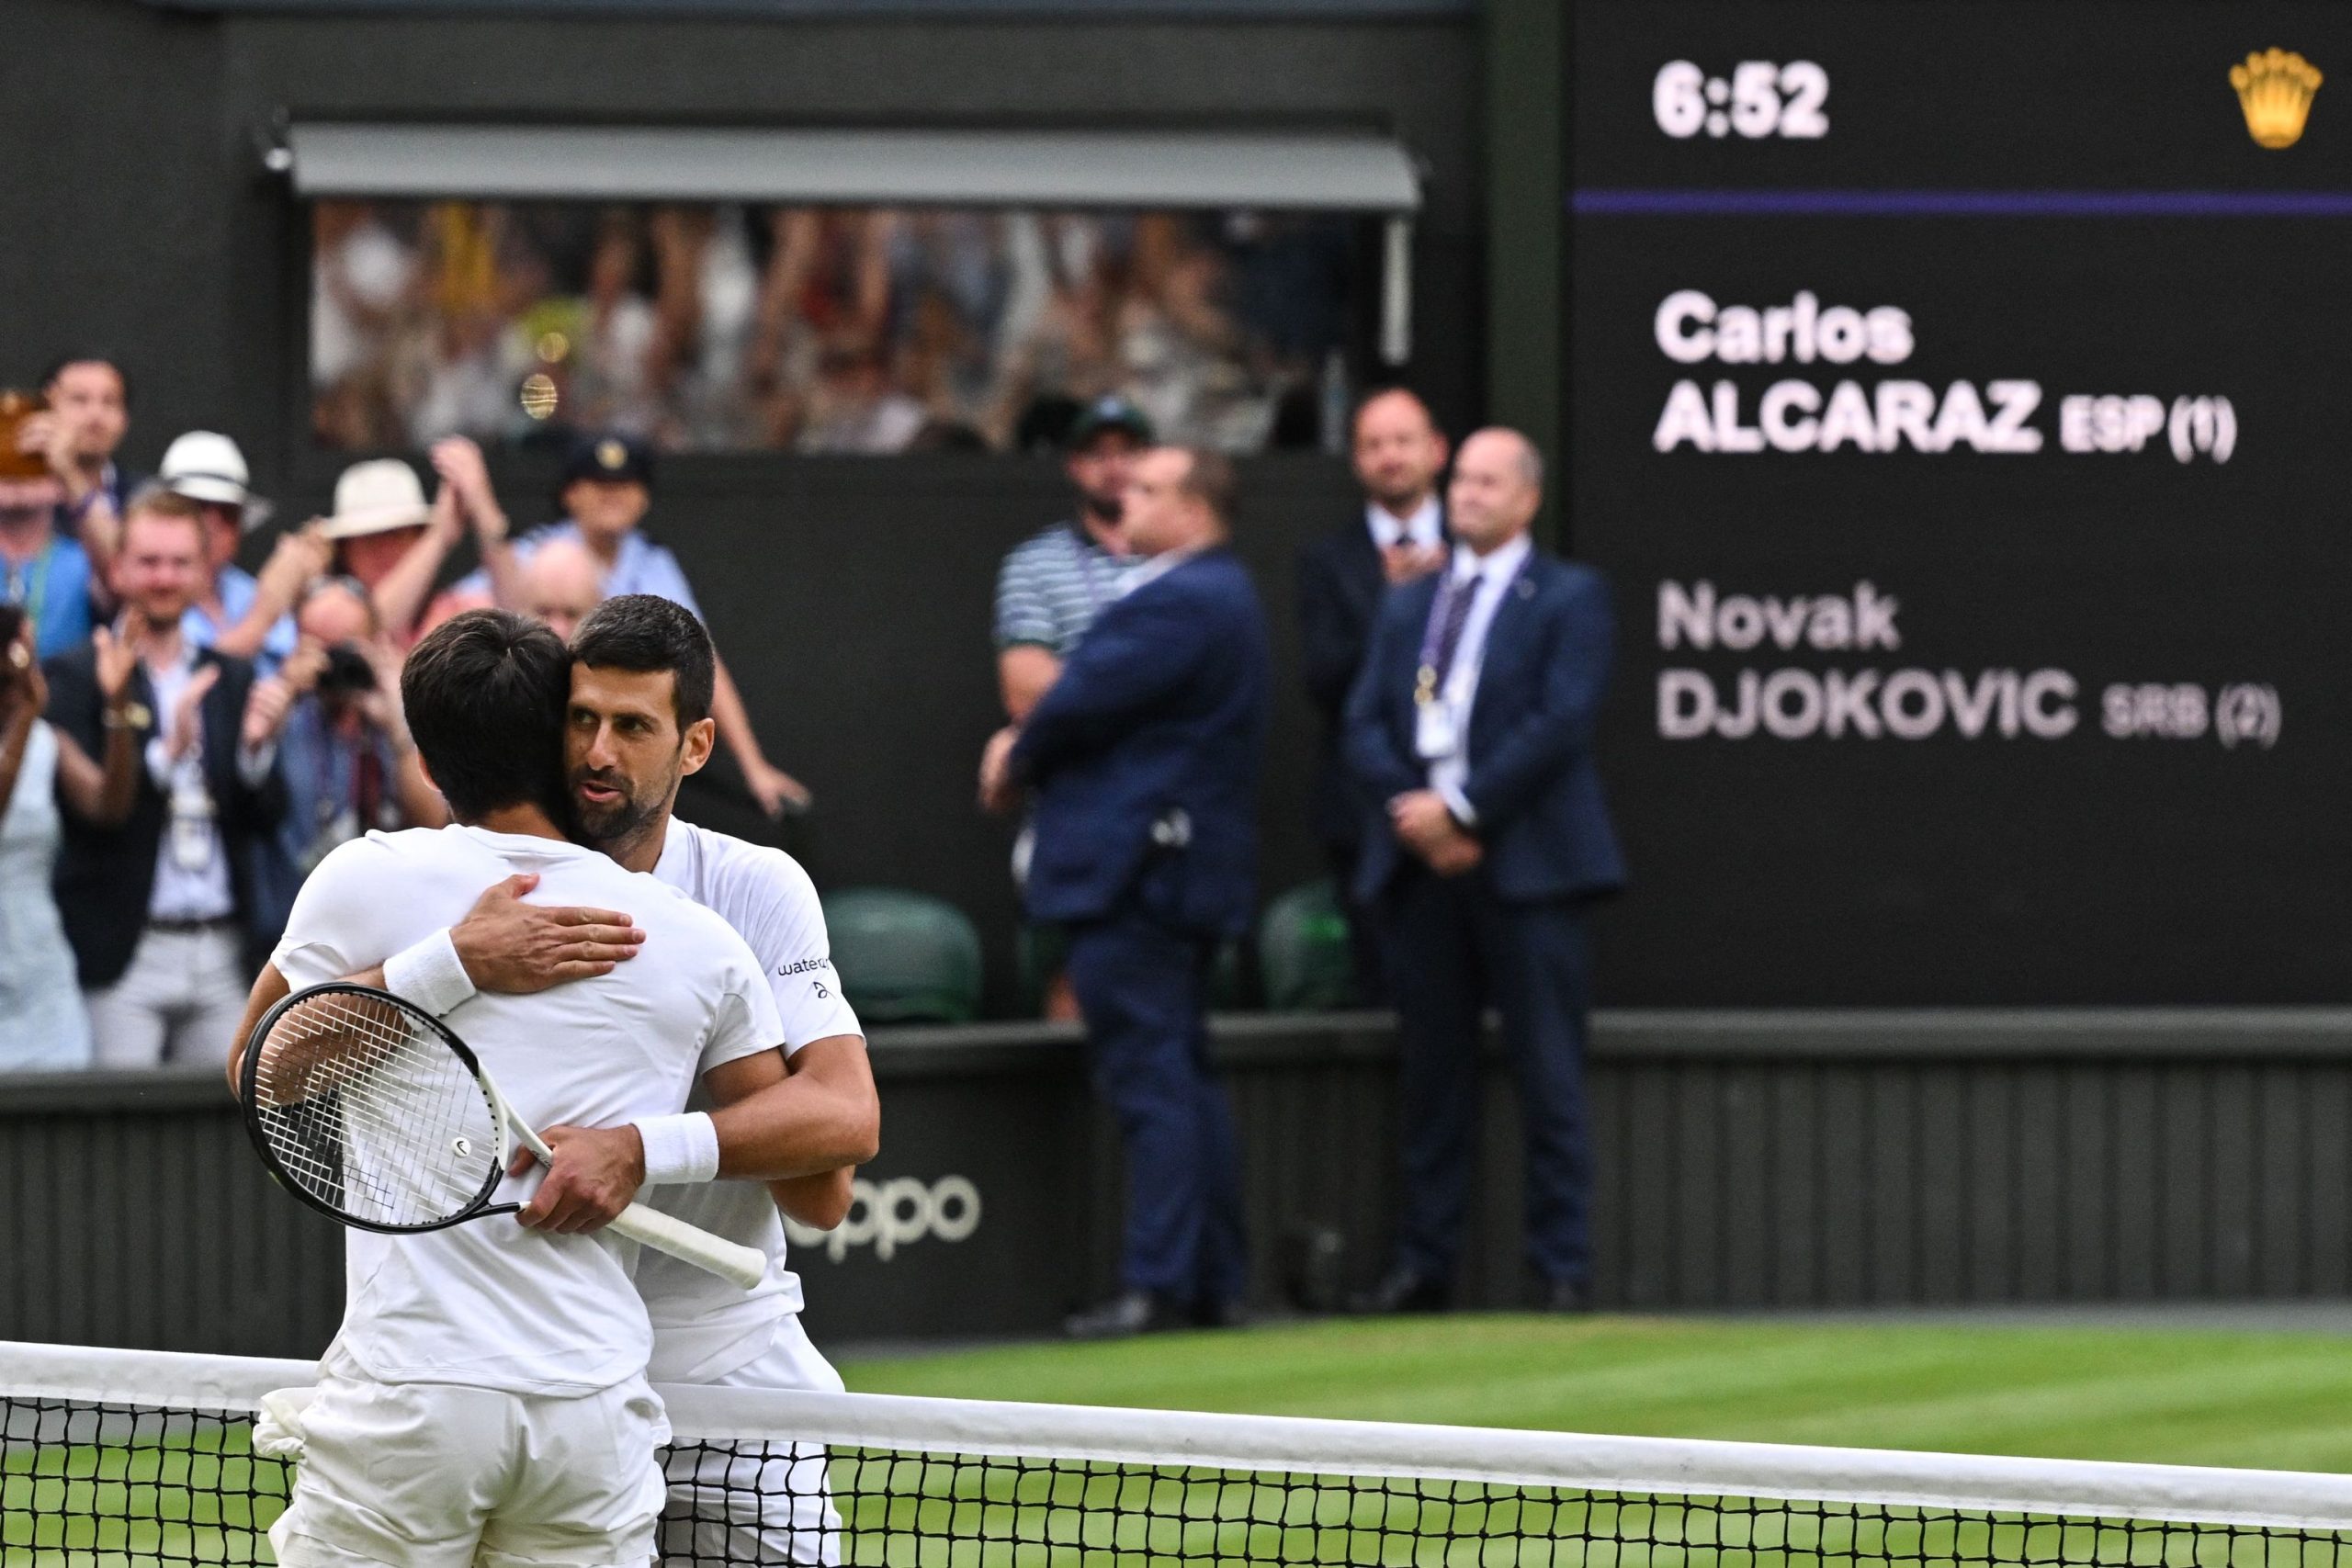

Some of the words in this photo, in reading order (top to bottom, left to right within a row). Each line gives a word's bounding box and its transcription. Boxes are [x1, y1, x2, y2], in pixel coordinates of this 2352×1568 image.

[1653, 60, 1829, 138] 6:52
[1655, 290, 1915, 364] Carlos
[1653, 379, 2043, 453] ALCARAZ
[2060, 395, 2165, 453] ESP
[2168, 395, 2238, 463] (1)
[1657, 581, 1901, 650] Novak
[1657, 669, 2078, 739] DJOKOVIC
[2101, 682, 2209, 739] SRB
